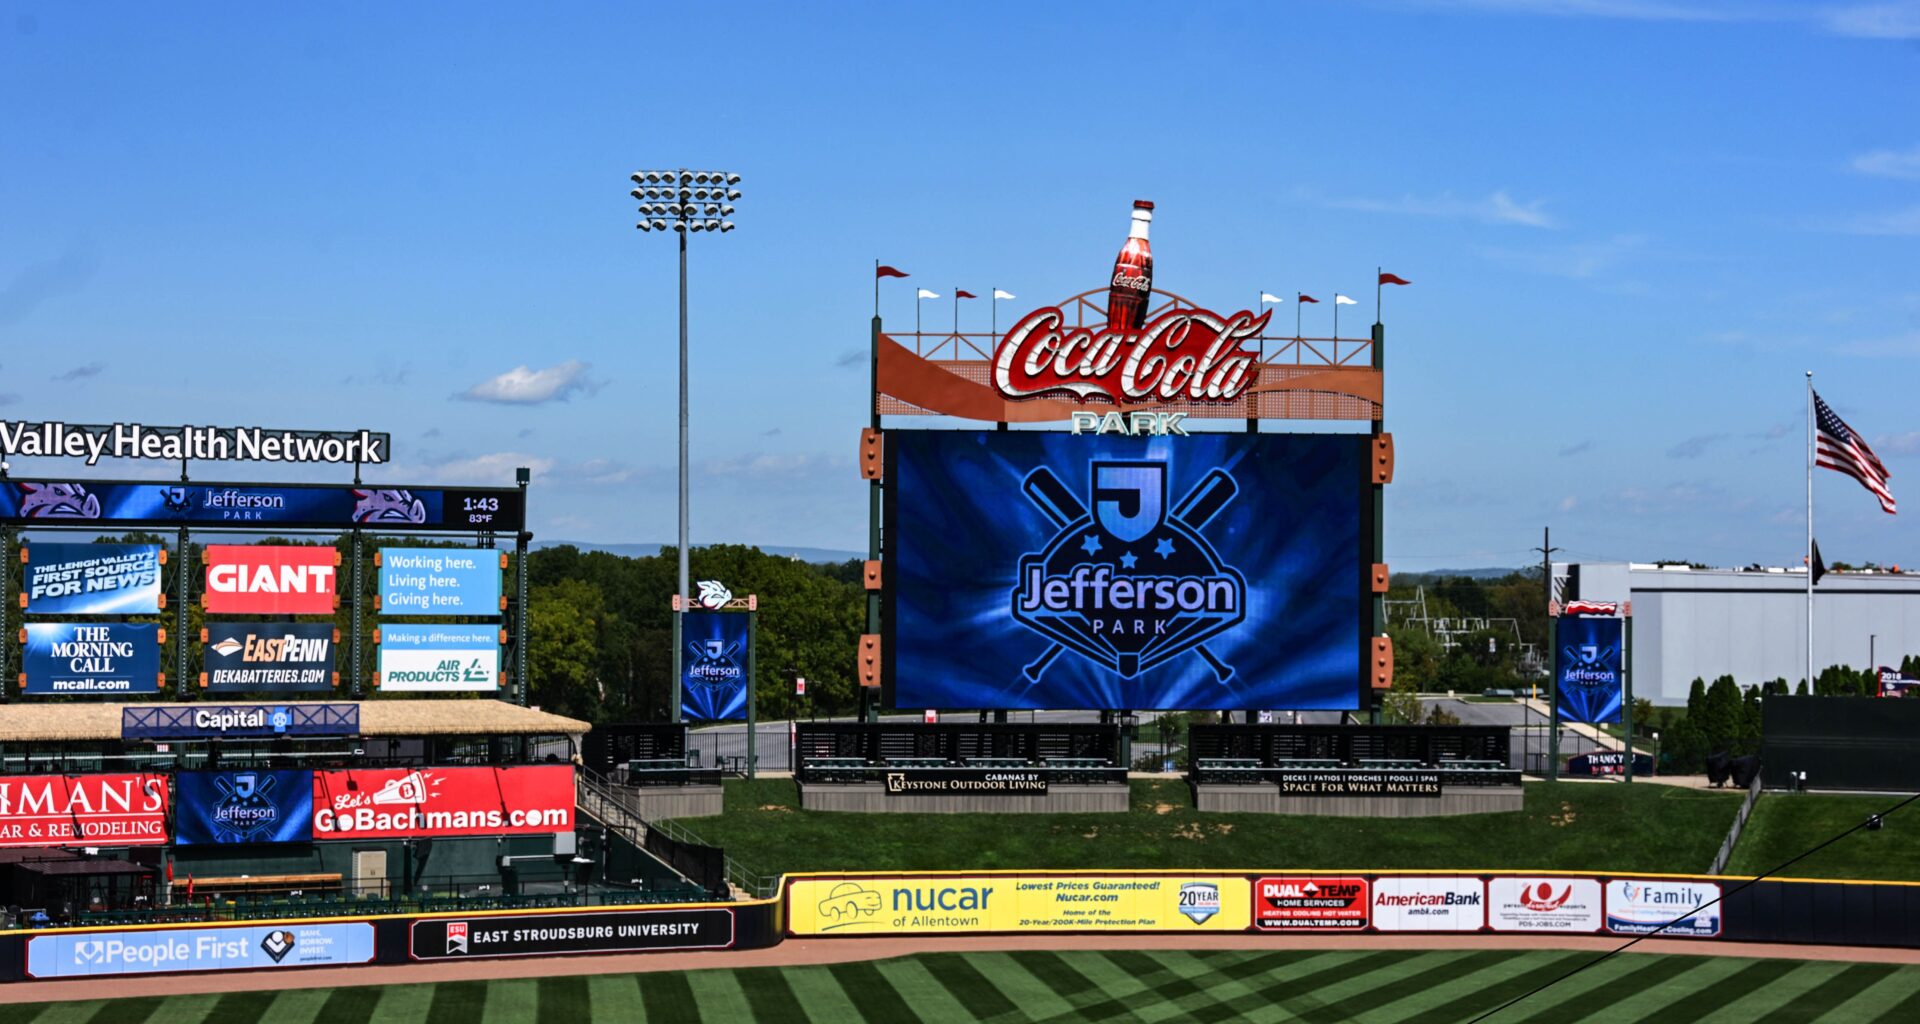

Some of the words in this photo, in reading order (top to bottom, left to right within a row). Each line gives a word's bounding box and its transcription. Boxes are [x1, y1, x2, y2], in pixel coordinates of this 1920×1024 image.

[1113, 271, 1150, 291] Coca-Cola
[994, 309, 1262, 400] Coca-Cola
[1071, 411, 1189, 436] PARK
[0, 421, 108, 464] Valley
[114, 423, 227, 459] Health
[236, 427, 381, 462] Network
[204, 489, 284, 508] Jefferson
[463, 497, 499, 511] 1:43
[223, 511, 262, 520] PARK
[469, 514, 493, 523] 83°F
[33, 564, 57, 573] THE
[57, 558, 100, 572] LEHIGH
[101, 551, 155, 565] VALLEY'S
[388, 555, 442, 572] Working
[445, 555, 476, 570] here.
[32, 569, 83, 585] FIRST
[84, 560, 154, 578] SOURCE
[208, 564, 334, 593] GIANT
[31, 581, 83, 600] FOR
[86, 571, 156, 592] NEWS
[388, 574, 426, 590] Living
[429, 574, 460, 588] here.
[1023, 568, 1235, 610] Jefferson
[388, 593, 430, 609] Giving
[432, 593, 464, 606] here.
[73, 626, 110, 642] THE
[1092, 619, 1167, 634] PARK
[387, 632, 420, 645] Making
[427, 632, 470, 643] difference
[471, 633, 493, 643] here.
[51, 642, 134, 658] MORNING
[70, 658, 115, 673] CALL
[437, 660, 460, 671] AIR
[689, 665, 740, 676] Jefferson
[212, 669, 325, 684] DEKABATTERIES.COM
[388, 671, 460, 683] PRODUCTS
[1565, 669, 1615, 681] Jefferson
[53, 678, 130, 690] mcall.com
[195, 710, 264, 731] Capital
[1587, 754, 1617, 765] THANK
[894, 780, 947, 790] KEYSTONE
[950, 780, 1006, 789] OUTDOOR
[1009, 780, 1046, 789] LIVING
[1283, 782, 1317, 792] SPACE
[1348, 783, 1383, 792] WHAT
[1386, 783, 1439, 792] MATTERS
[334, 792, 371, 810] Let's
[214, 805, 275, 820] Jefferson
[314, 808, 568, 832] GoBachmans.com
[28, 822, 42, 837] &
[48, 820, 162, 837] REMODELING
[1016, 881, 1054, 891] Lowest
[1056, 881, 1090, 890] Prices
[1093, 881, 1161, 890] Guaranteed!
[1263, 884, 1304, 897] DUAL
[1318, 884, 1361, 897] TEMP
[892, 887, 994, 911] nucar
[1056, 893, 1119, 902] Nucar.com
[1179, 891, 1197, 906] 20
[1196, 891, 1219, 901] YEAR
[1277, 899, 1302, 907] HOME
[1303, 899, 1345, 907] SERVICES
[1375, 891, 1481, 907] AmericanBank
[1644, 887, 1703, 908] Family
[1408, 907, 1450, 916] ambk.com
[892, 916, 906, 927] of
[911, 915, 979, 927] Allentown
[1095, 918, 1136, 926] Protection
[1264, 919, 1360, 927] WWW.DUALTEMP.COM
[450, 925, 466, 934] ESU
[473, 931, 509, 943] EAST
[513, 926, 613, 941] STROUDSBURG
[618, 923, 700, 937] UNIVERSITY
[105, 938, 190, 967] People
[196, 936, 249, 960] First
